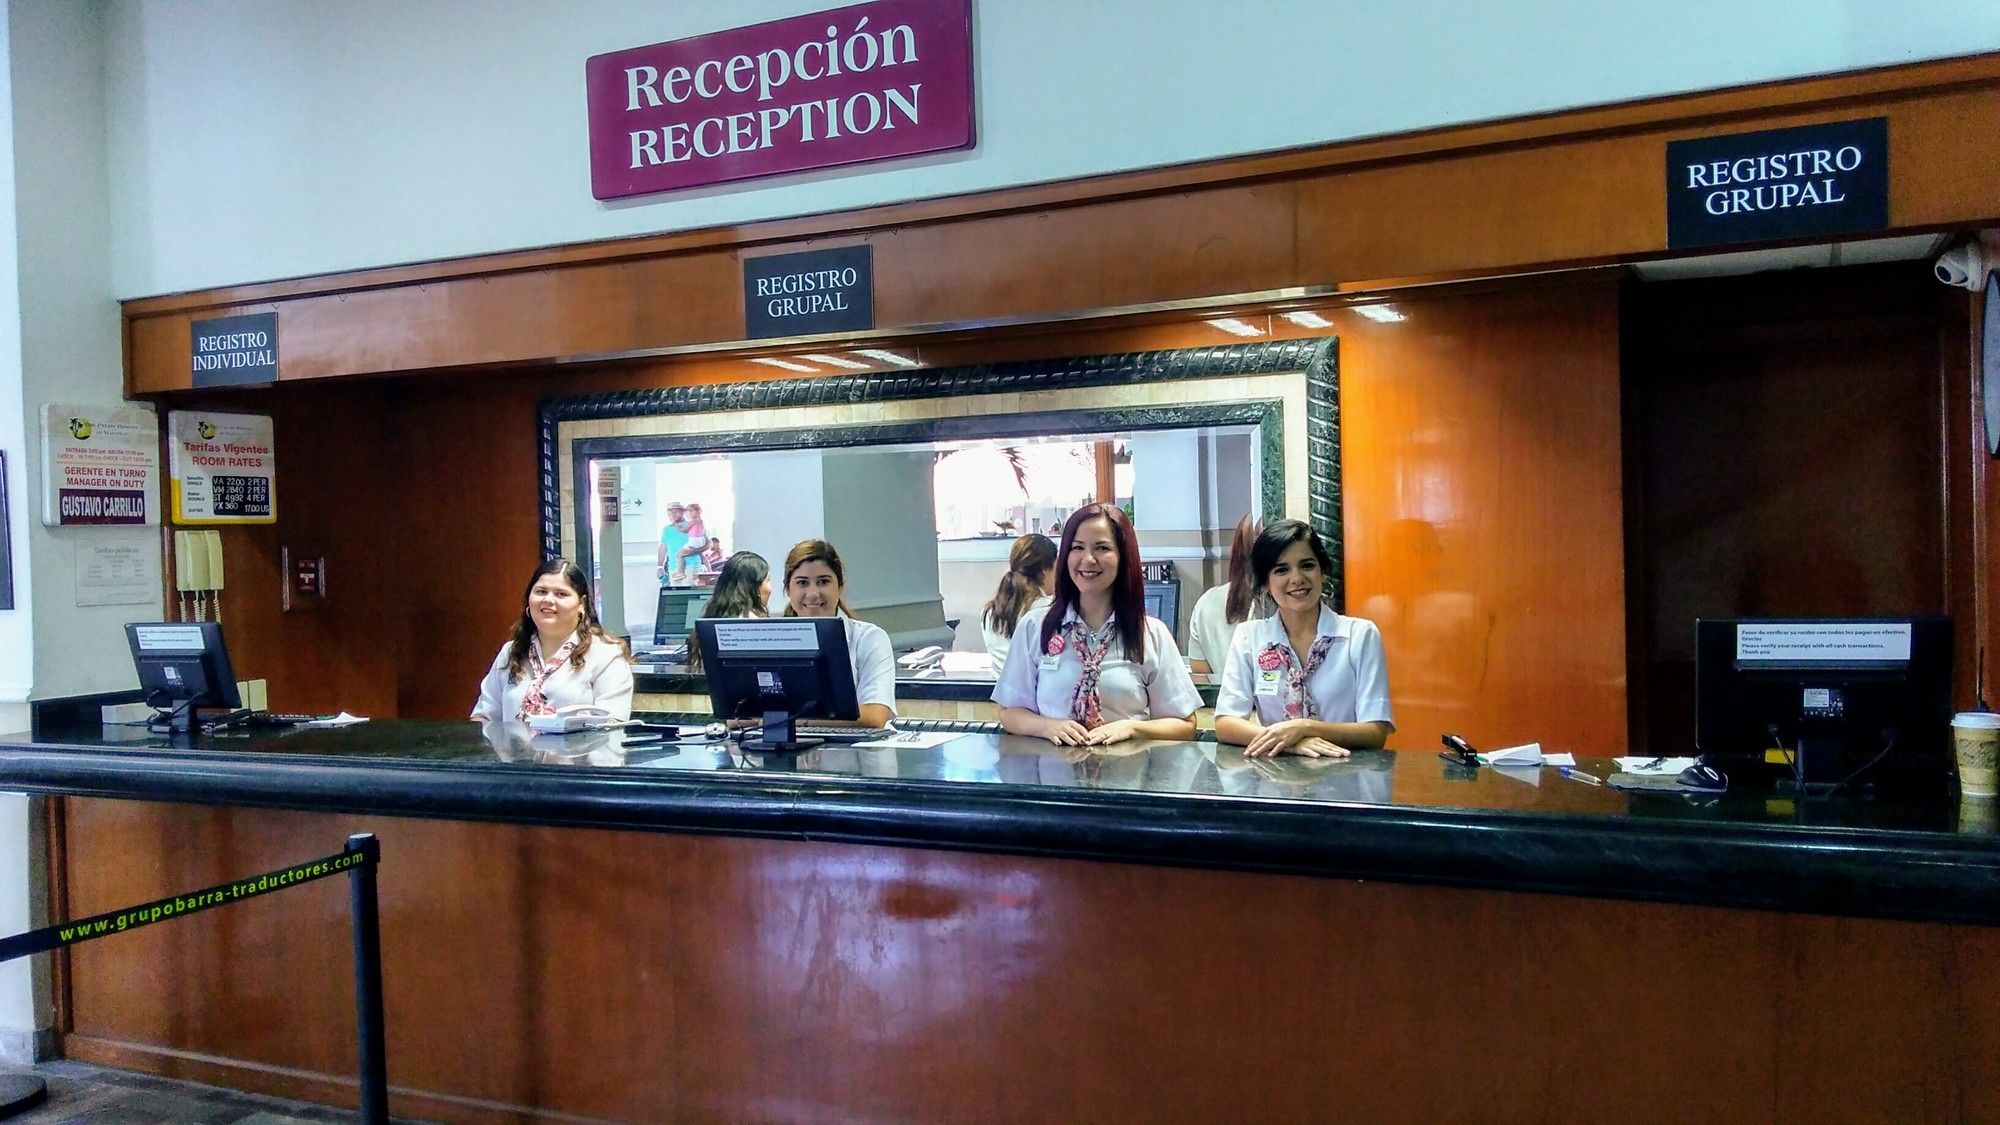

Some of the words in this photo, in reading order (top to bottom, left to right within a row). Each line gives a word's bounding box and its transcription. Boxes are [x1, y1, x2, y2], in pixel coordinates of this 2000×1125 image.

[625, 16, 918, 112] Recepción
[629, 83, 922, 169] RECEPTION
[1687, 146, 1862, 188] REGISTRO
[1705, 179, 1846, 215] GRUPAL
[757, 267, 857, 297] REGISTRO
[768, 292, 848, 318] GRUPAL
[199, 331, 267, 352] REGISTRO
[193, 350, 275, 371] INDIVIDUAL
[184, 442, 220, 453] Tarifas
[223, 443, 268, 455] Vigentes
[65, 466, 103, 476] GERENTE
[106, 468, 116, 477] EN
[119, 469, 146, 478] TURNO
[192, 456, 225, 466] ROOM
[229, 457, 262, 467] RATES
[66, 477, 107, 487] MANAGER
[110, 479, 121, 487] ON
[123, 480, 145, 488] DUTY
[226, 477, 245, 487] 2200
[247, 478, 252, 486] 2
[253, 478, 267, 486] PER
[226, 486, 244, 494] 2840
[247, 486, 252, 494] 2
[253, 486, 266, 494] PER
[62, 496, 102, 517] GUSTAVO
[103, 496, 144, 518] CARRILLO
[213, 502, 224, 510] PX
[225, 494, 244, 502] 4992
[246, 494, 252, 502] 4
[253, 494, 266, 502] PER
[60, 850, 364, 941] www.grupobarra-traductores.com
